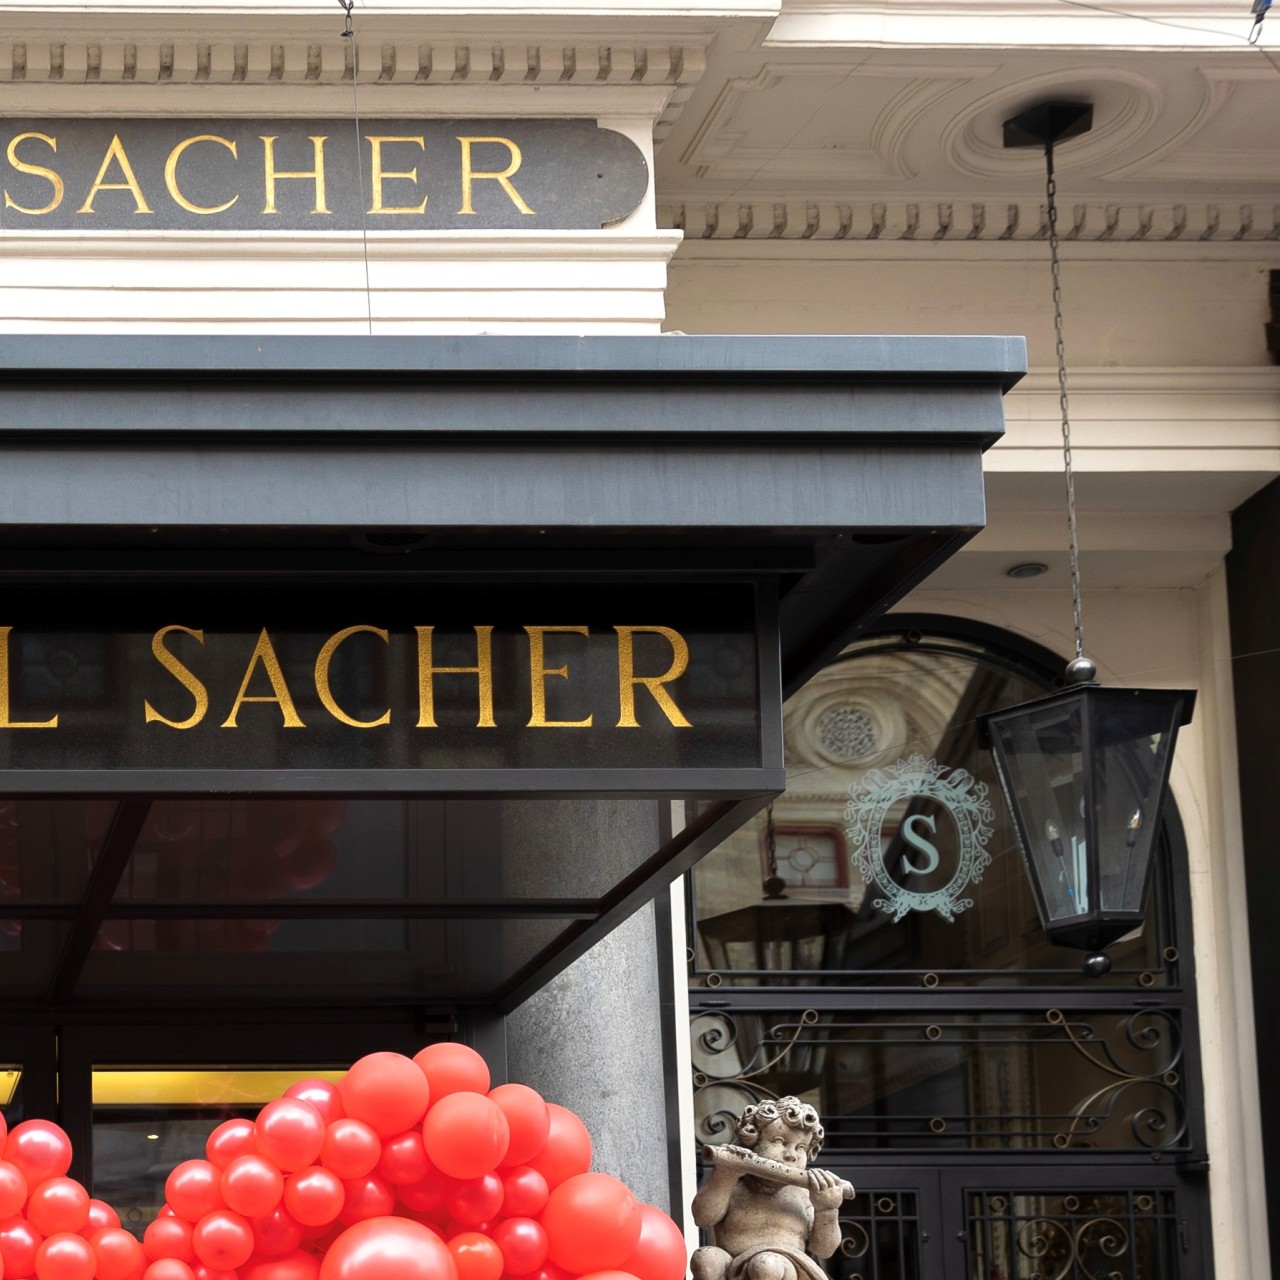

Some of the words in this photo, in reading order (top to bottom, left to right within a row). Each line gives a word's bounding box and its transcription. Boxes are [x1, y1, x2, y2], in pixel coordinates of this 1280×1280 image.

[4, 131, 534, 215] SACHER
[143, 623, 693, 732] SACHER
[902, 814, 939, 874] S
